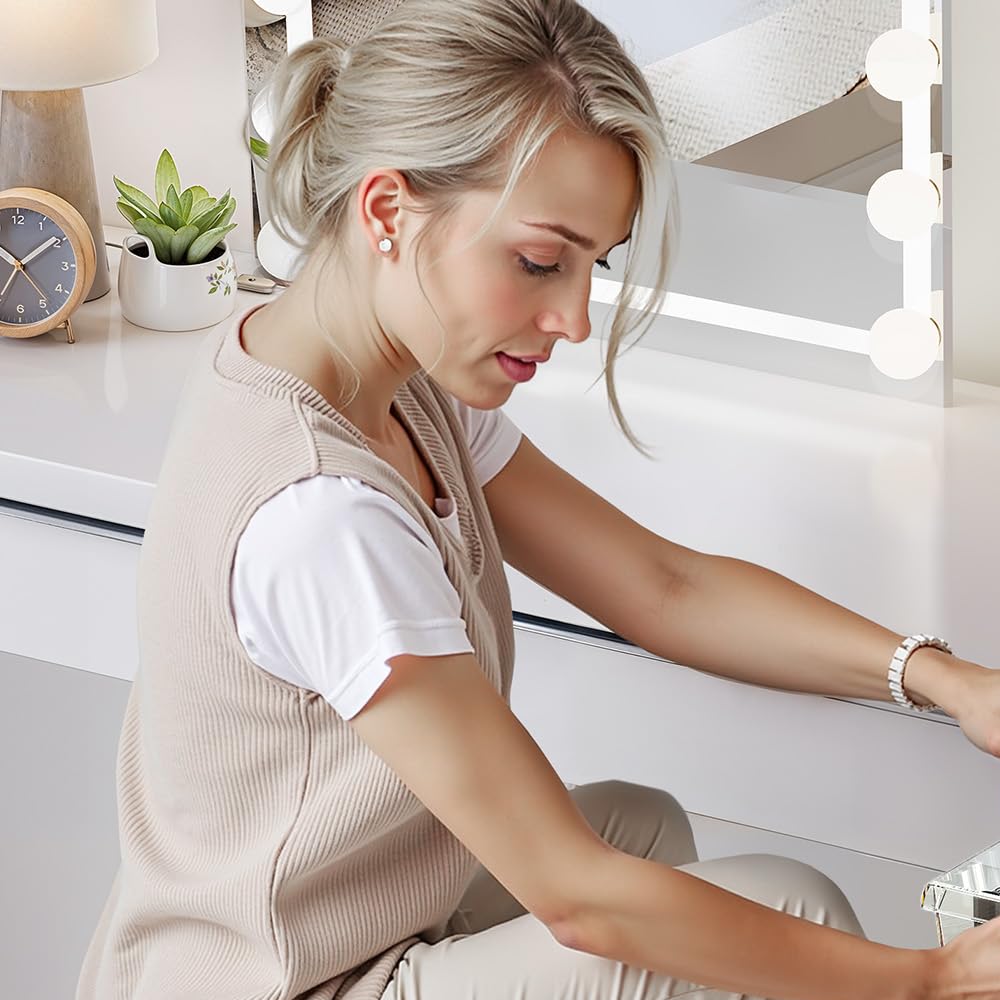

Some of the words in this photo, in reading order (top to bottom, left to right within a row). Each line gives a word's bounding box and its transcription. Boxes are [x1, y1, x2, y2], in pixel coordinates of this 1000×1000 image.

[12, 215, 25, 225] 12
[38, 222, 43, 231] 1
[53, 238, 61, 248] 2
[61, 261, 69, 271] 3
[54, 283, 63, 293] 4
[16, 304, 25, 313] 6
[39, 299, 47, 309] 5
